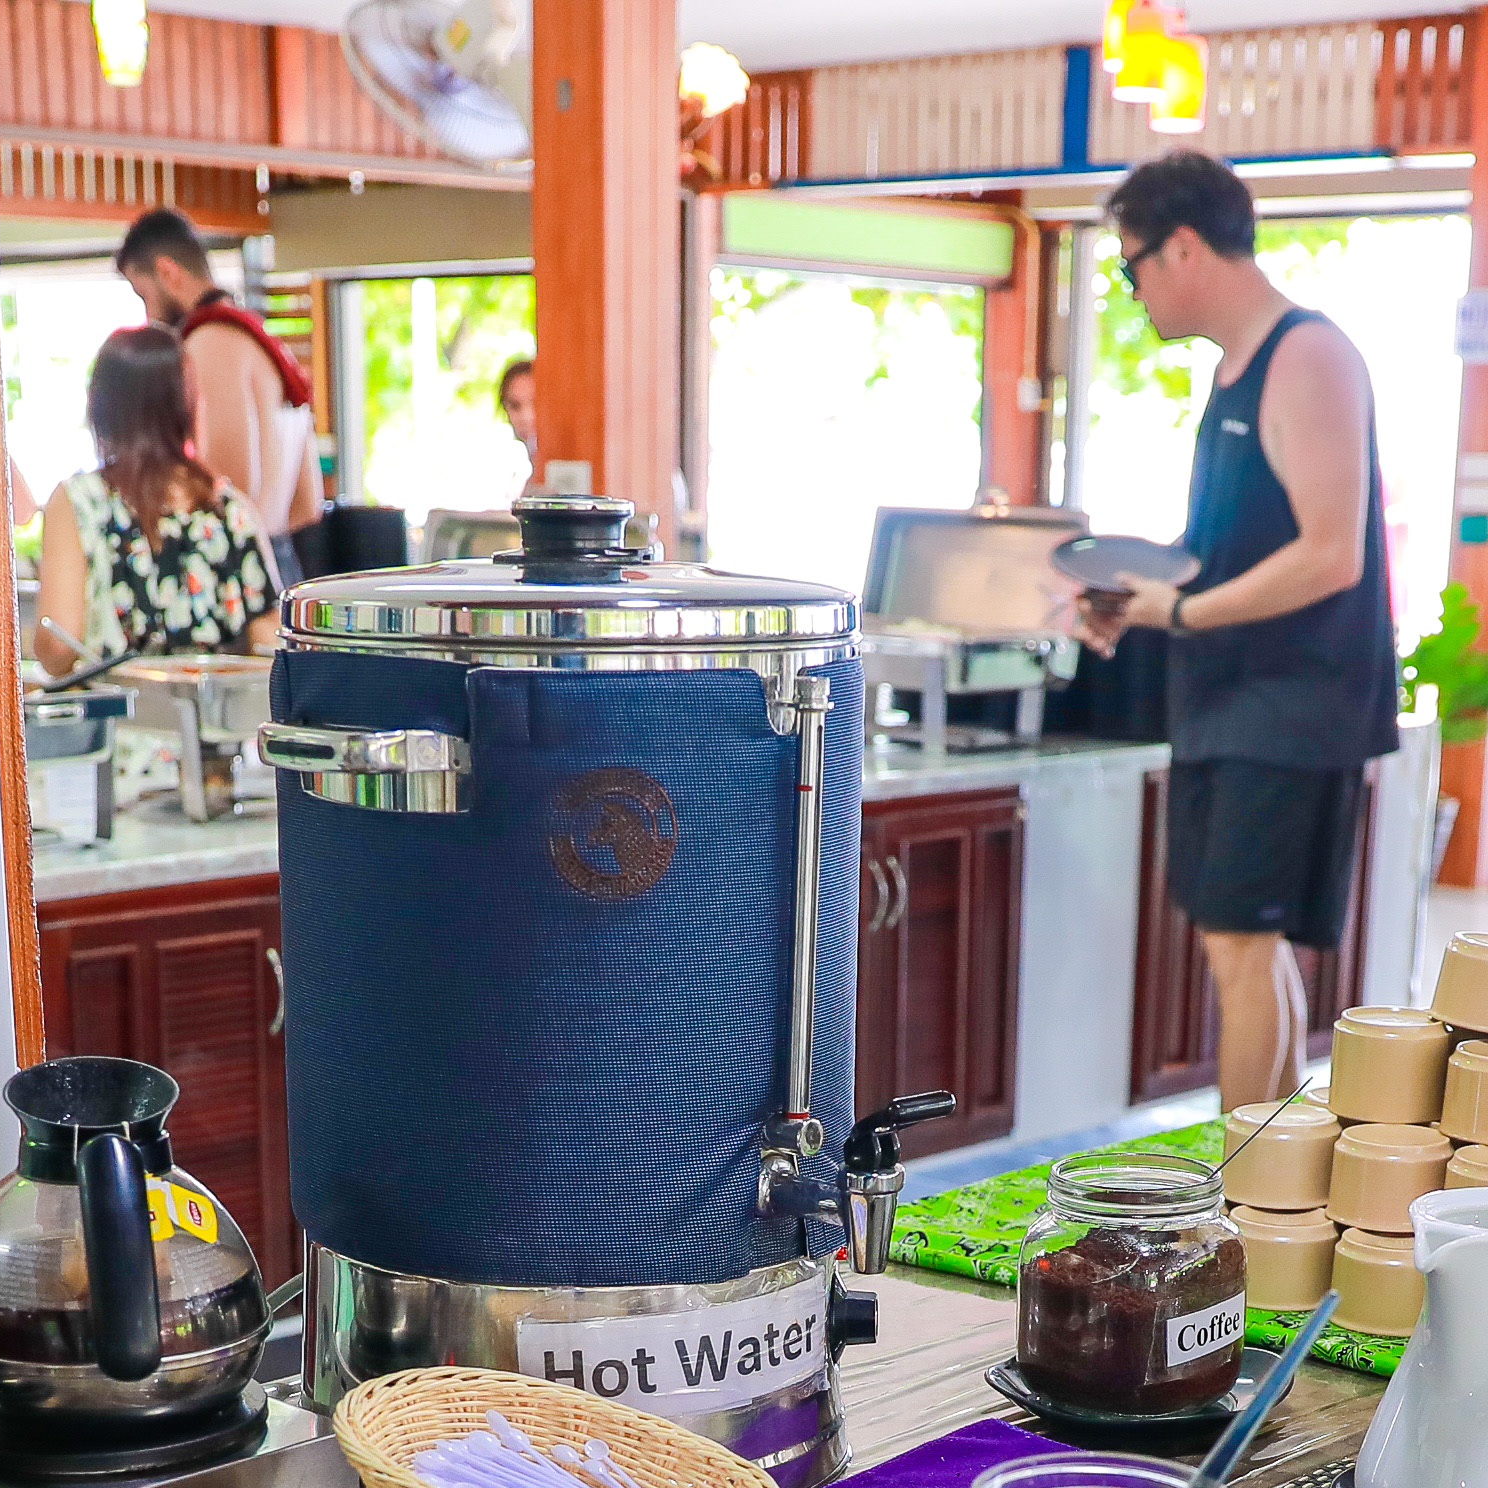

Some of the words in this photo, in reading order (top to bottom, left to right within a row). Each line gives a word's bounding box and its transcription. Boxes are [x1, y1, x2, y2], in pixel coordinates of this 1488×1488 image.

[542, 1347, 657, 1398] Hot
[674, 1313, 816, 1387] Water
[1177, 1311, 1240, 1352] Coffee
